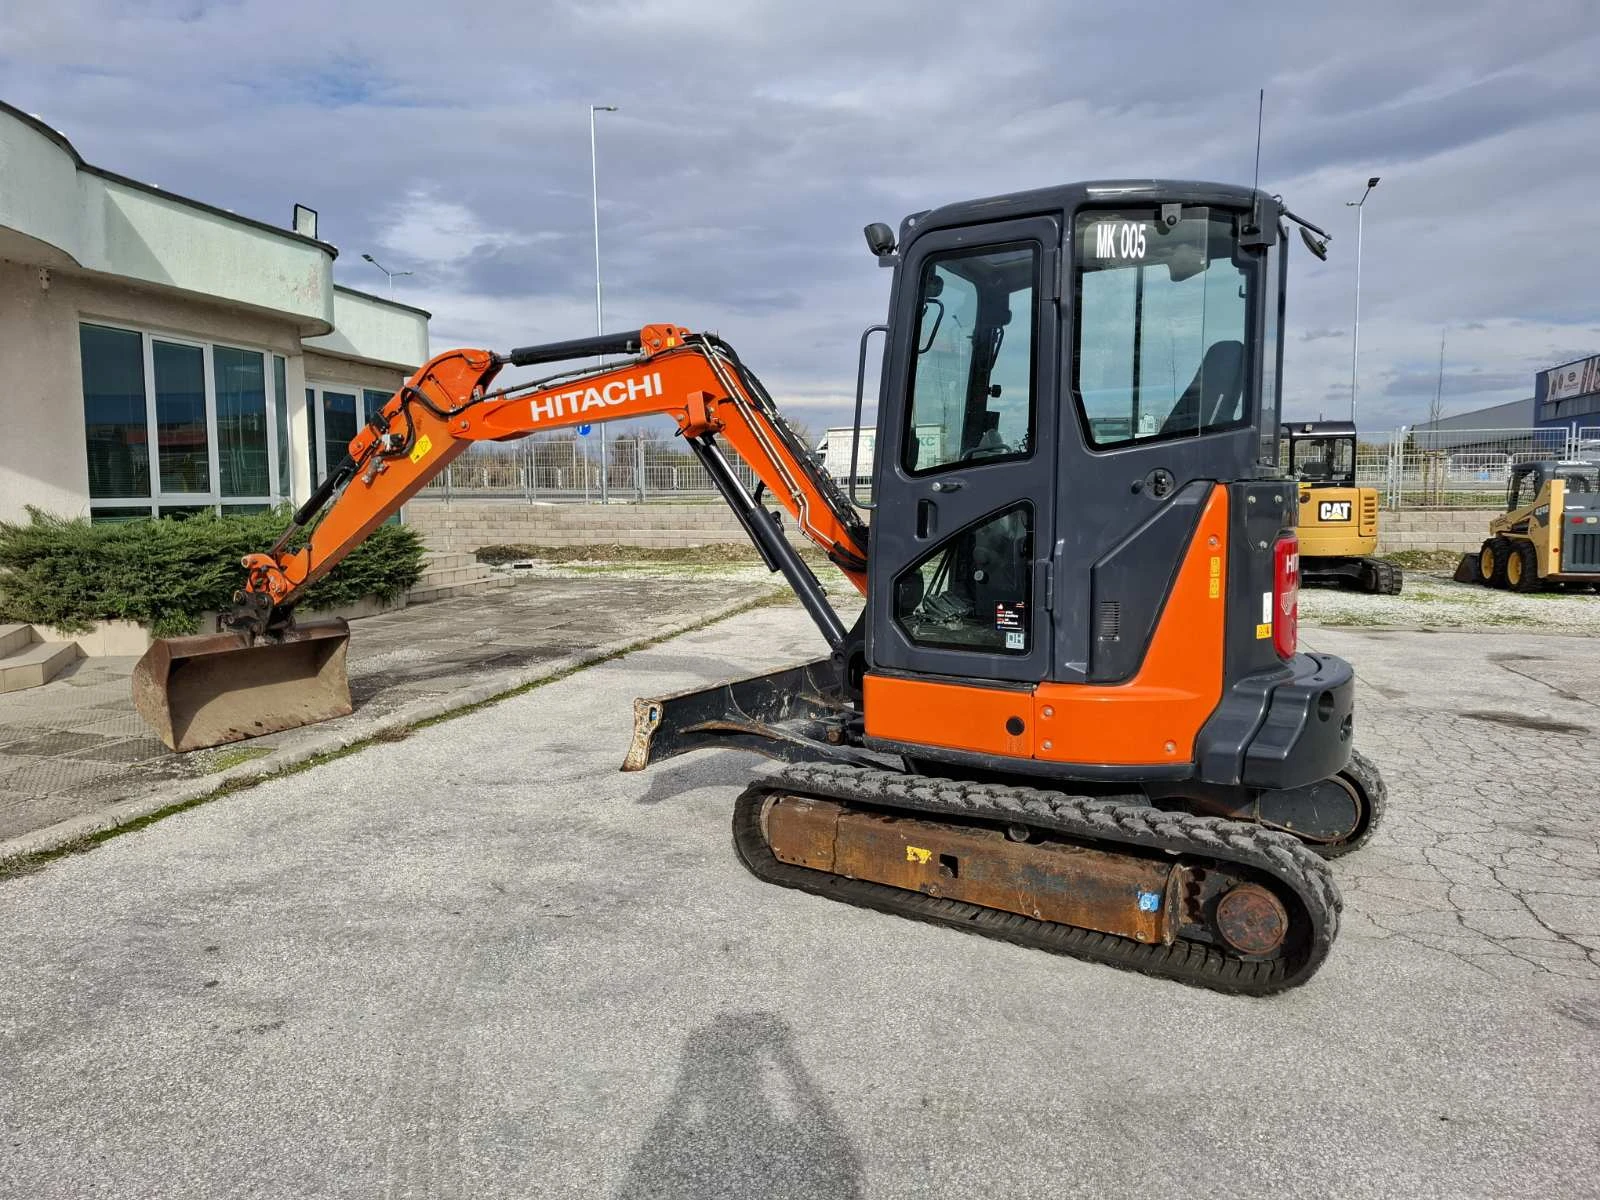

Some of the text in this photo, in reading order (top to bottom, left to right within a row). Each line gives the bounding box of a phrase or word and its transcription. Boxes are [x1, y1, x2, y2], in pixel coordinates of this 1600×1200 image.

[1096, 223, 1146, 258] MK 005
[530, 372, 663, 421] HITACHI
[1320, 502, 1351, 520] CAT
